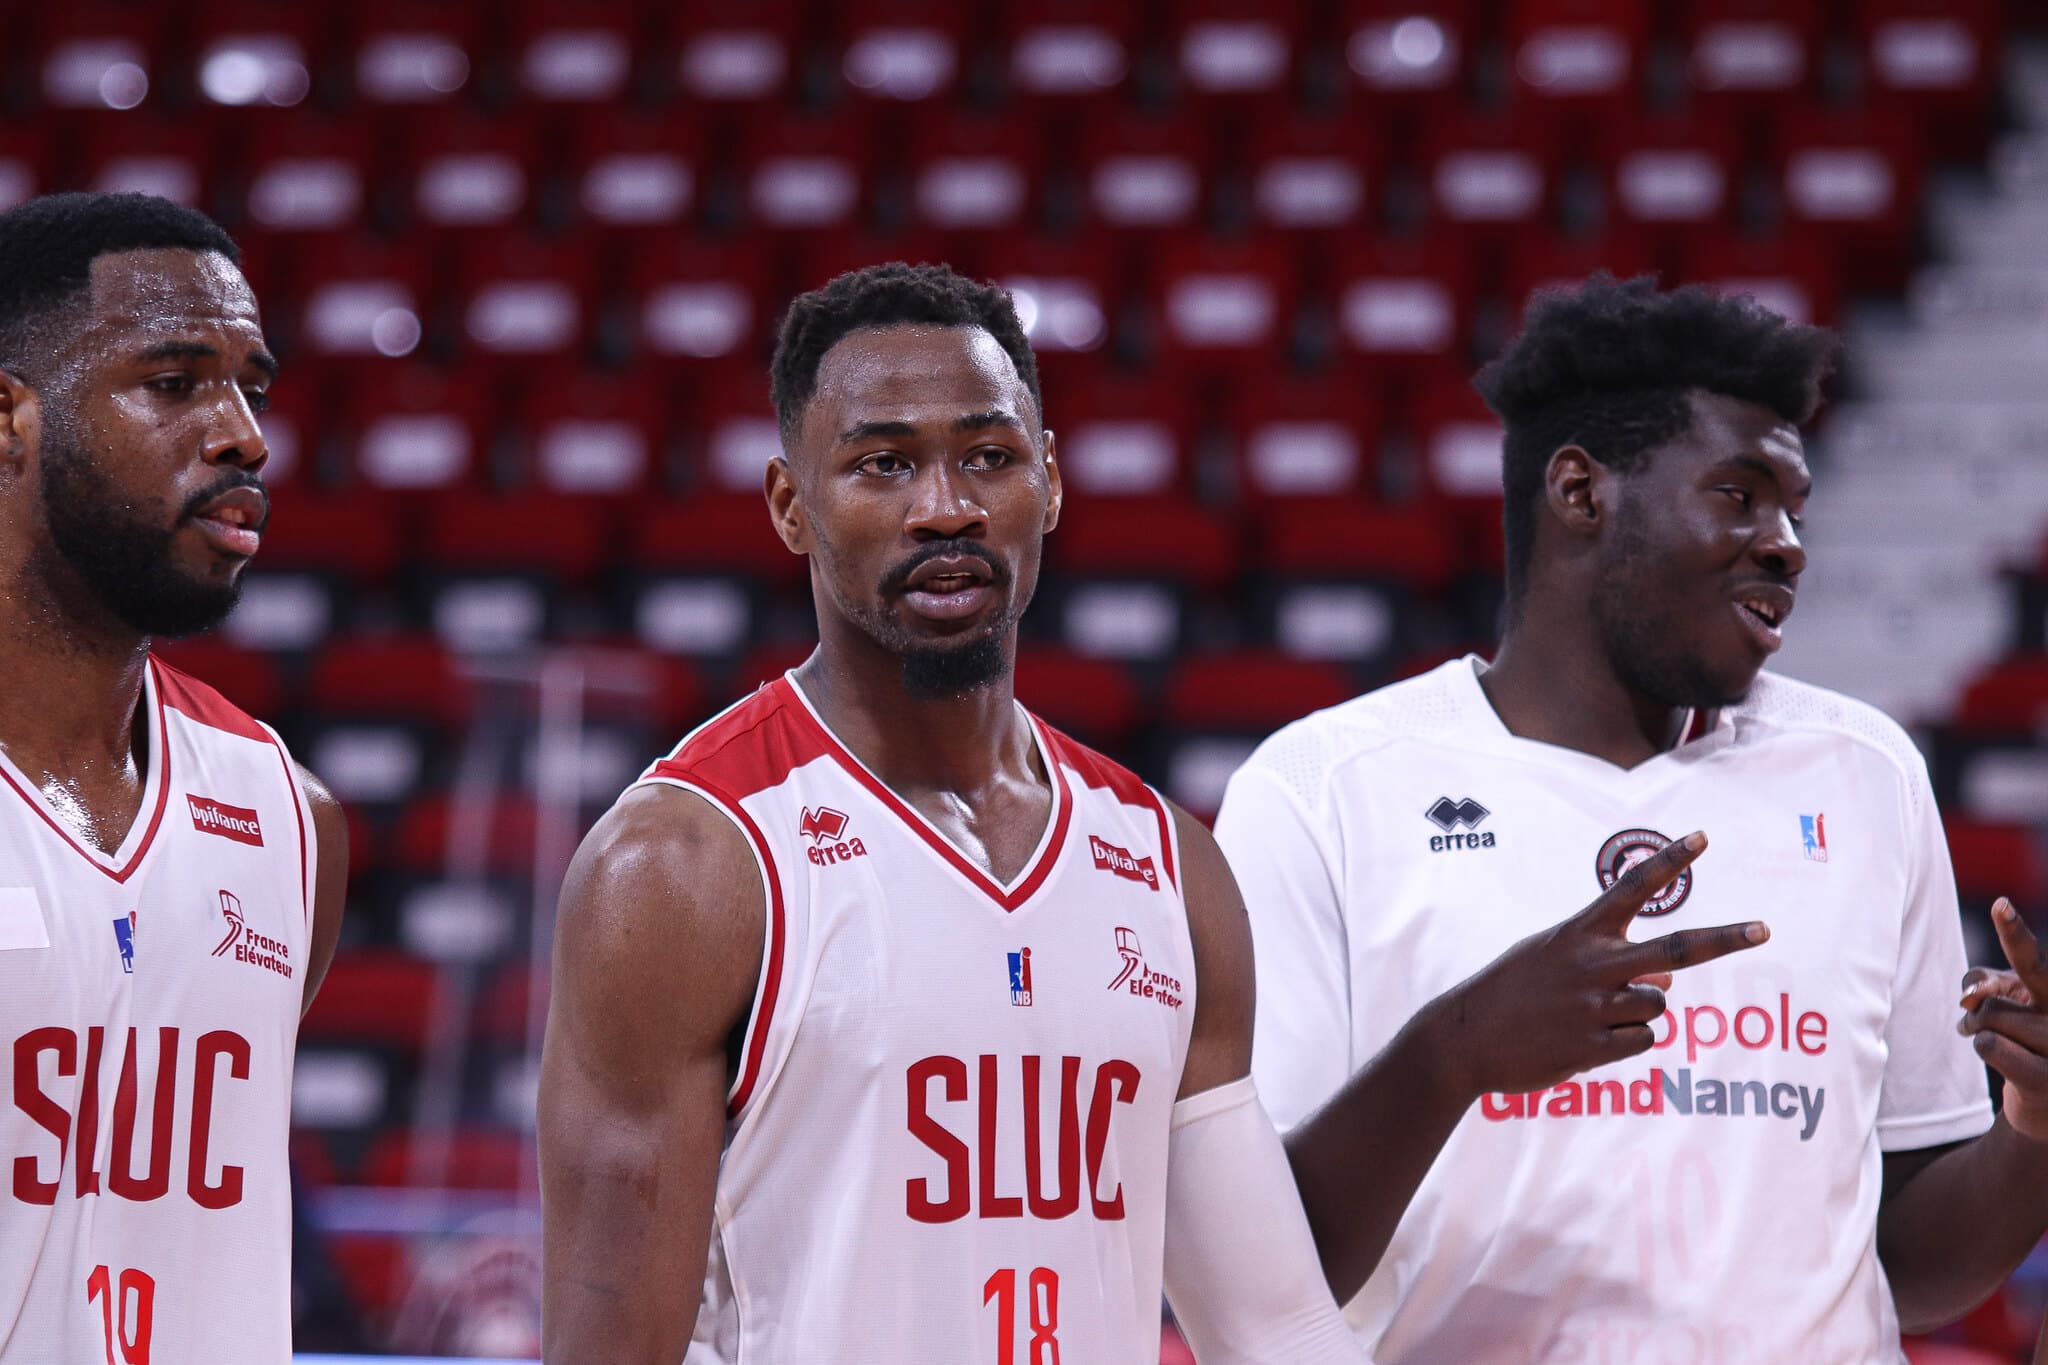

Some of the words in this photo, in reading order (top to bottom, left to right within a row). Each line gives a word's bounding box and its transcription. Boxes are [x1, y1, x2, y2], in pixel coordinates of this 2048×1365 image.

[190, 800, 260, 836] bpifrance
[807, 837, 868, 867] errea
[1429, 831, 1497, 853] errea
[246, 928, 289, 959] France
[235, 944, 293, 980] Elévateur
[13, 1026, 252, 1210] SLUC
[906, 1054, 1142, 1224] SLUC
[983, 1266, 1061, 1365] 18
